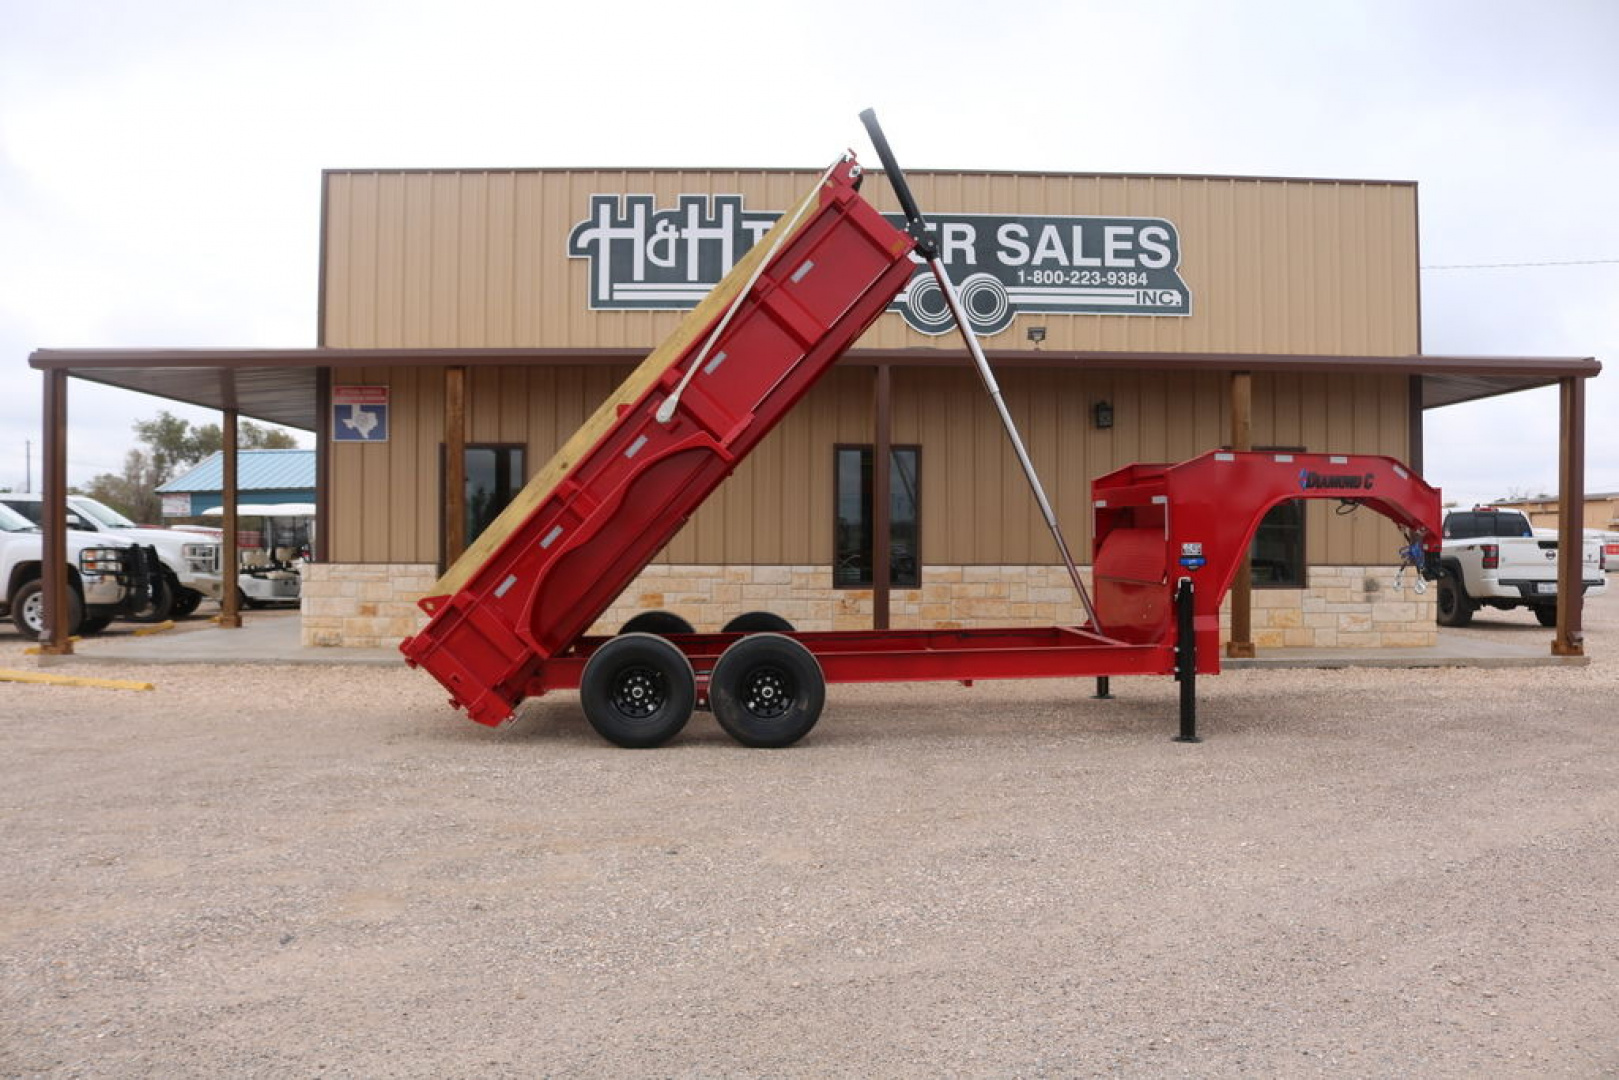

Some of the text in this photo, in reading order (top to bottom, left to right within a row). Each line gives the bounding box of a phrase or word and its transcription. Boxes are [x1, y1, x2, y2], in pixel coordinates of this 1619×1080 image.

[577, 203, 734, 300] H&H
[997, 223, 1171, 268] SALES
[1018, 270, 1149, 286] 1-800-223-9384
[1136, 290, 1181, 305] INC.
[1364, 473, 1375, 490] C
